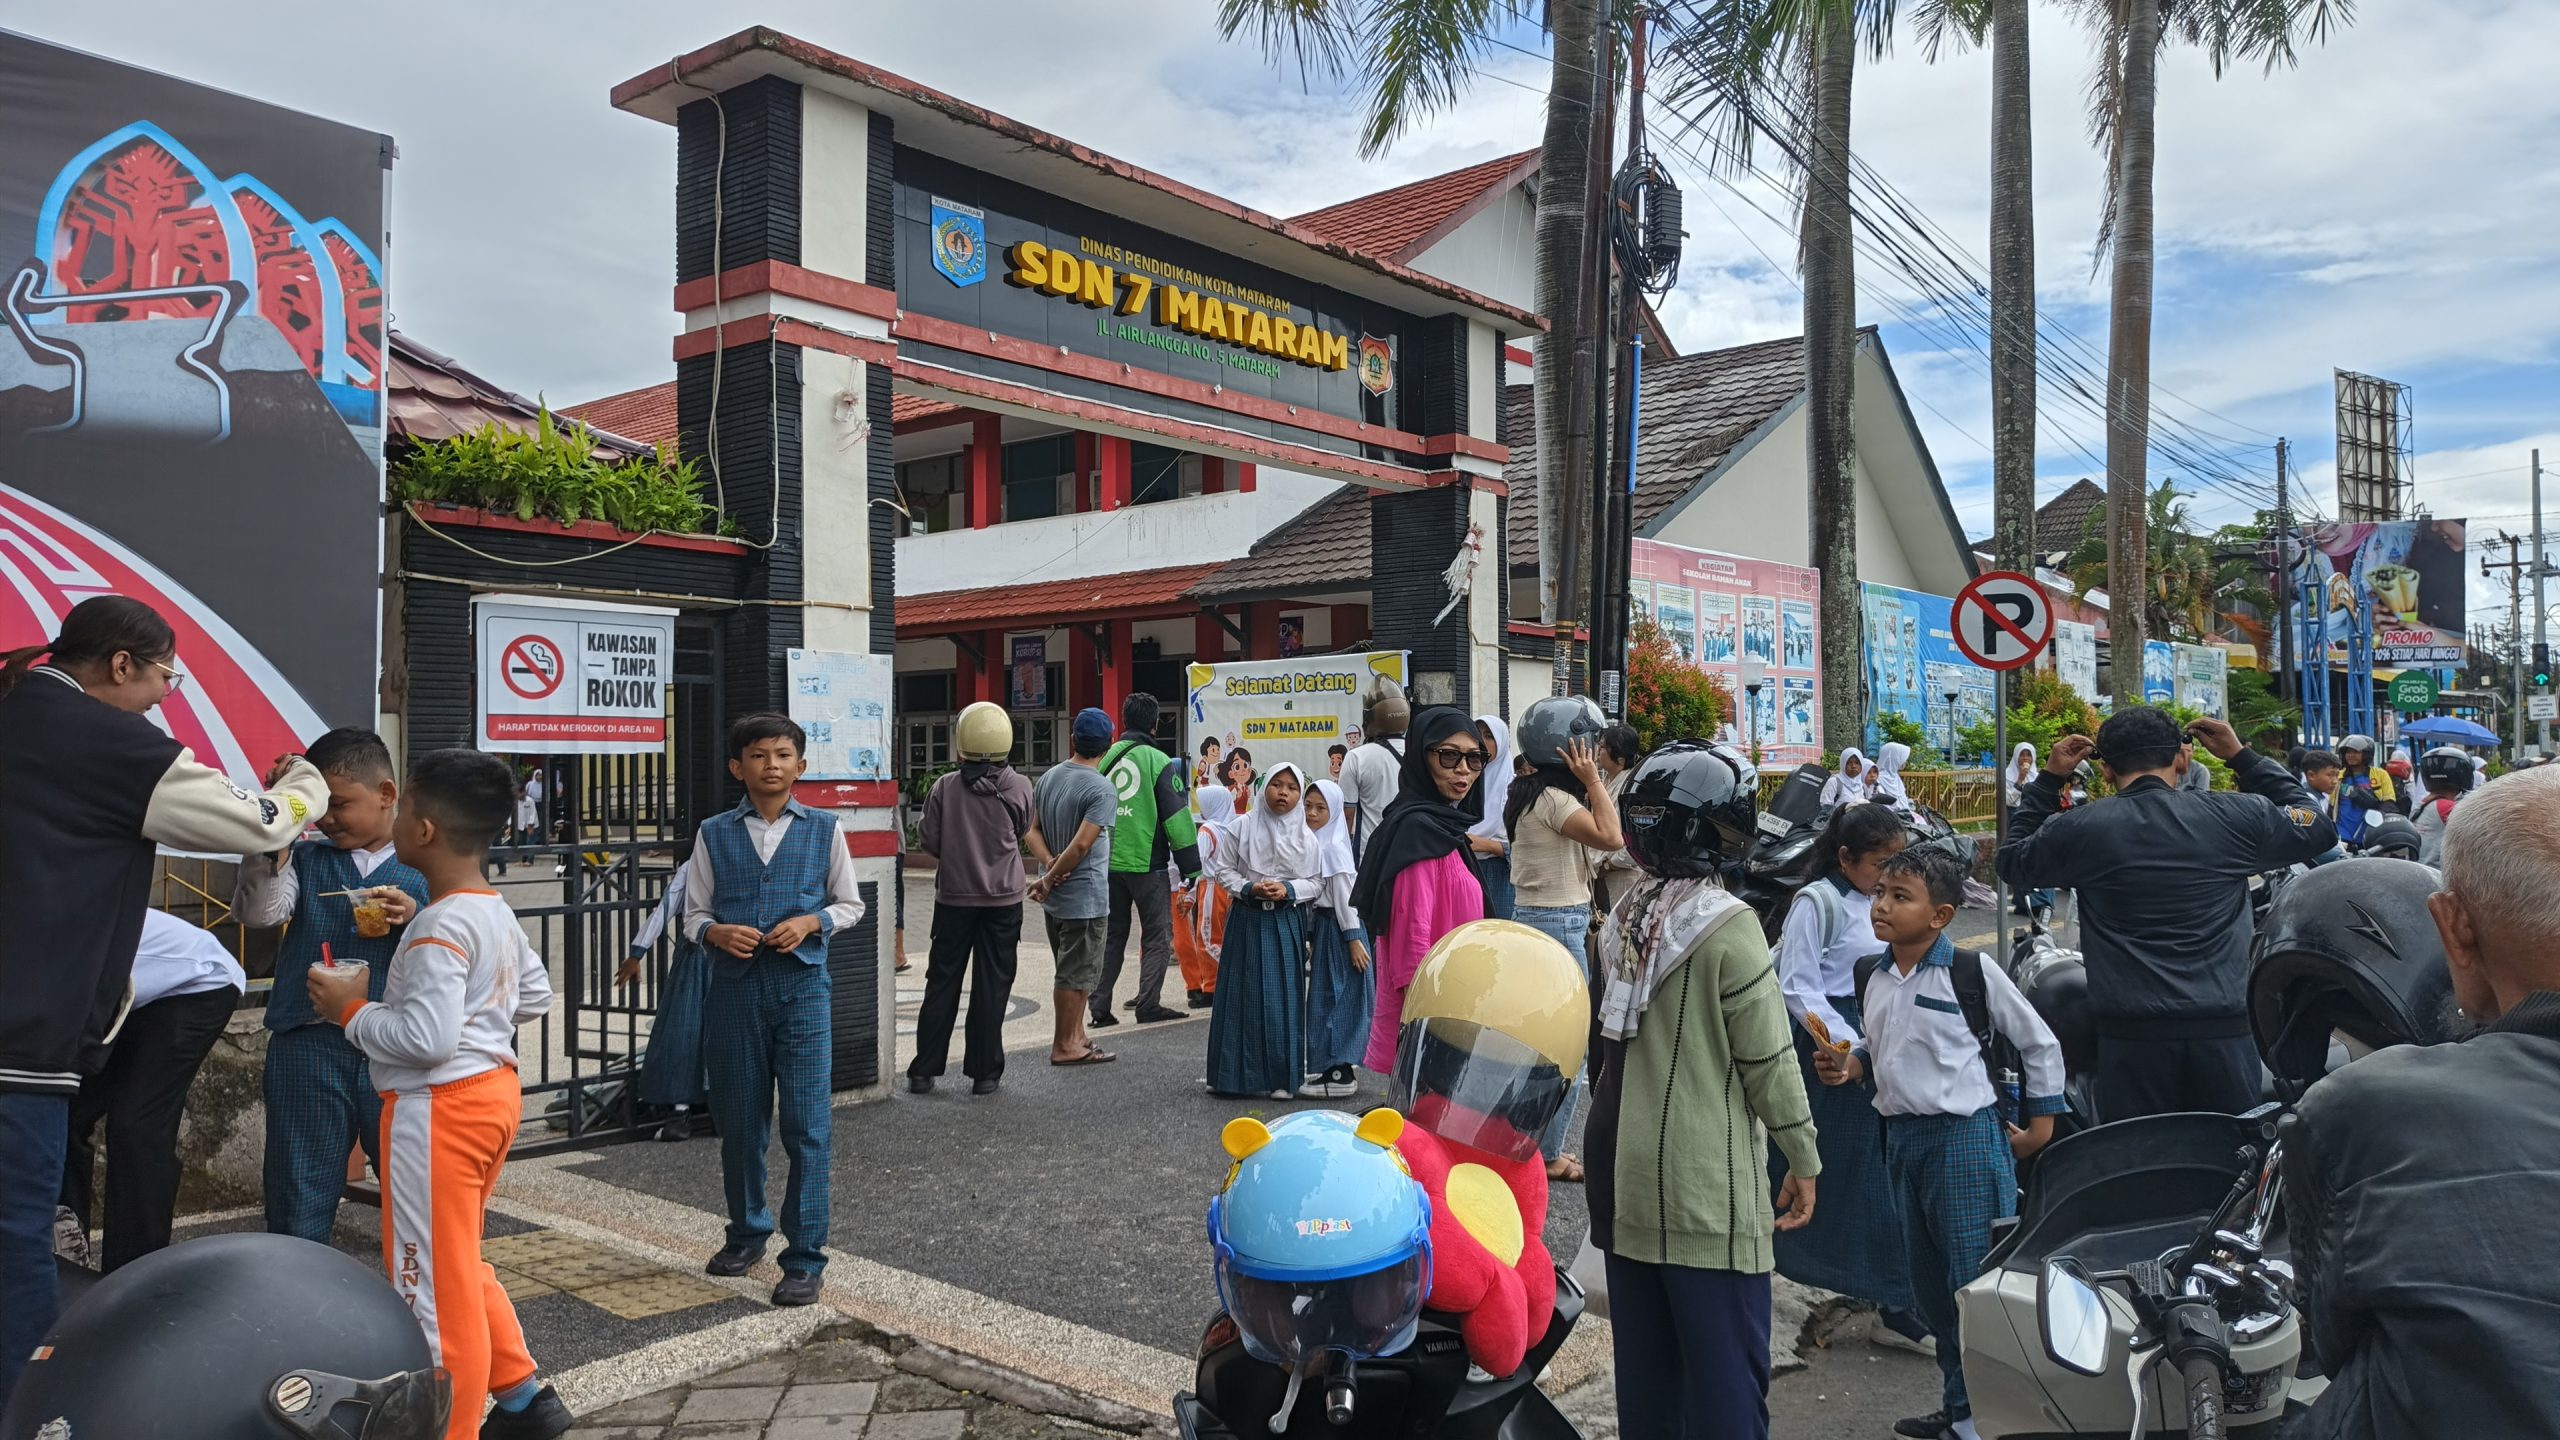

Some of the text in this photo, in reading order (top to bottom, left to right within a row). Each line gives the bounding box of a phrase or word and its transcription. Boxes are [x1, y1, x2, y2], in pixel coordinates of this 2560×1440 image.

[934, 198, 982, 217] KOTA MATARAM
[1080, 236, 1291, 314] DINAS PENDIDIKAN KOTA MATARAM
[1012, 240, 1349, 372] SDN 7 MATARAM
[1097, 318, 1281, 379] JL. AIRLANGGA NO. 5 MATARAM
[1701, 562, 1734, 572] KEGIATAN
[587, 632, 657, 655] KAWASAN
[2383, 630, 2434, 645] PROMO
[2375, 648, 2391, 661] 10%
[2391, 648, 2414, 661] SETIAP
[2414, 648, 2431, 660] HARI
[2431, 647, 2460, 660] MINGGU
[612, 657, 656, 677] TANPA
[1226, 672, 1356, 696] Selamat Datang
[2399, 684, 2428, 694] Grab
[587, 678, 657, 708] ROKOK
[2398, 694, 2428, 703] Food
[1284, 700, 1293, 710] di
[498, 723, 656, 734] HARAP TIDAK MEROKOK DI AREA INI
[1246, 720, 1334, 734] SDN 7 MATARAM
[401, 1242, 420, 1311] SDN 7
[1425, 1340, 1460, 1353] YAMAHA
